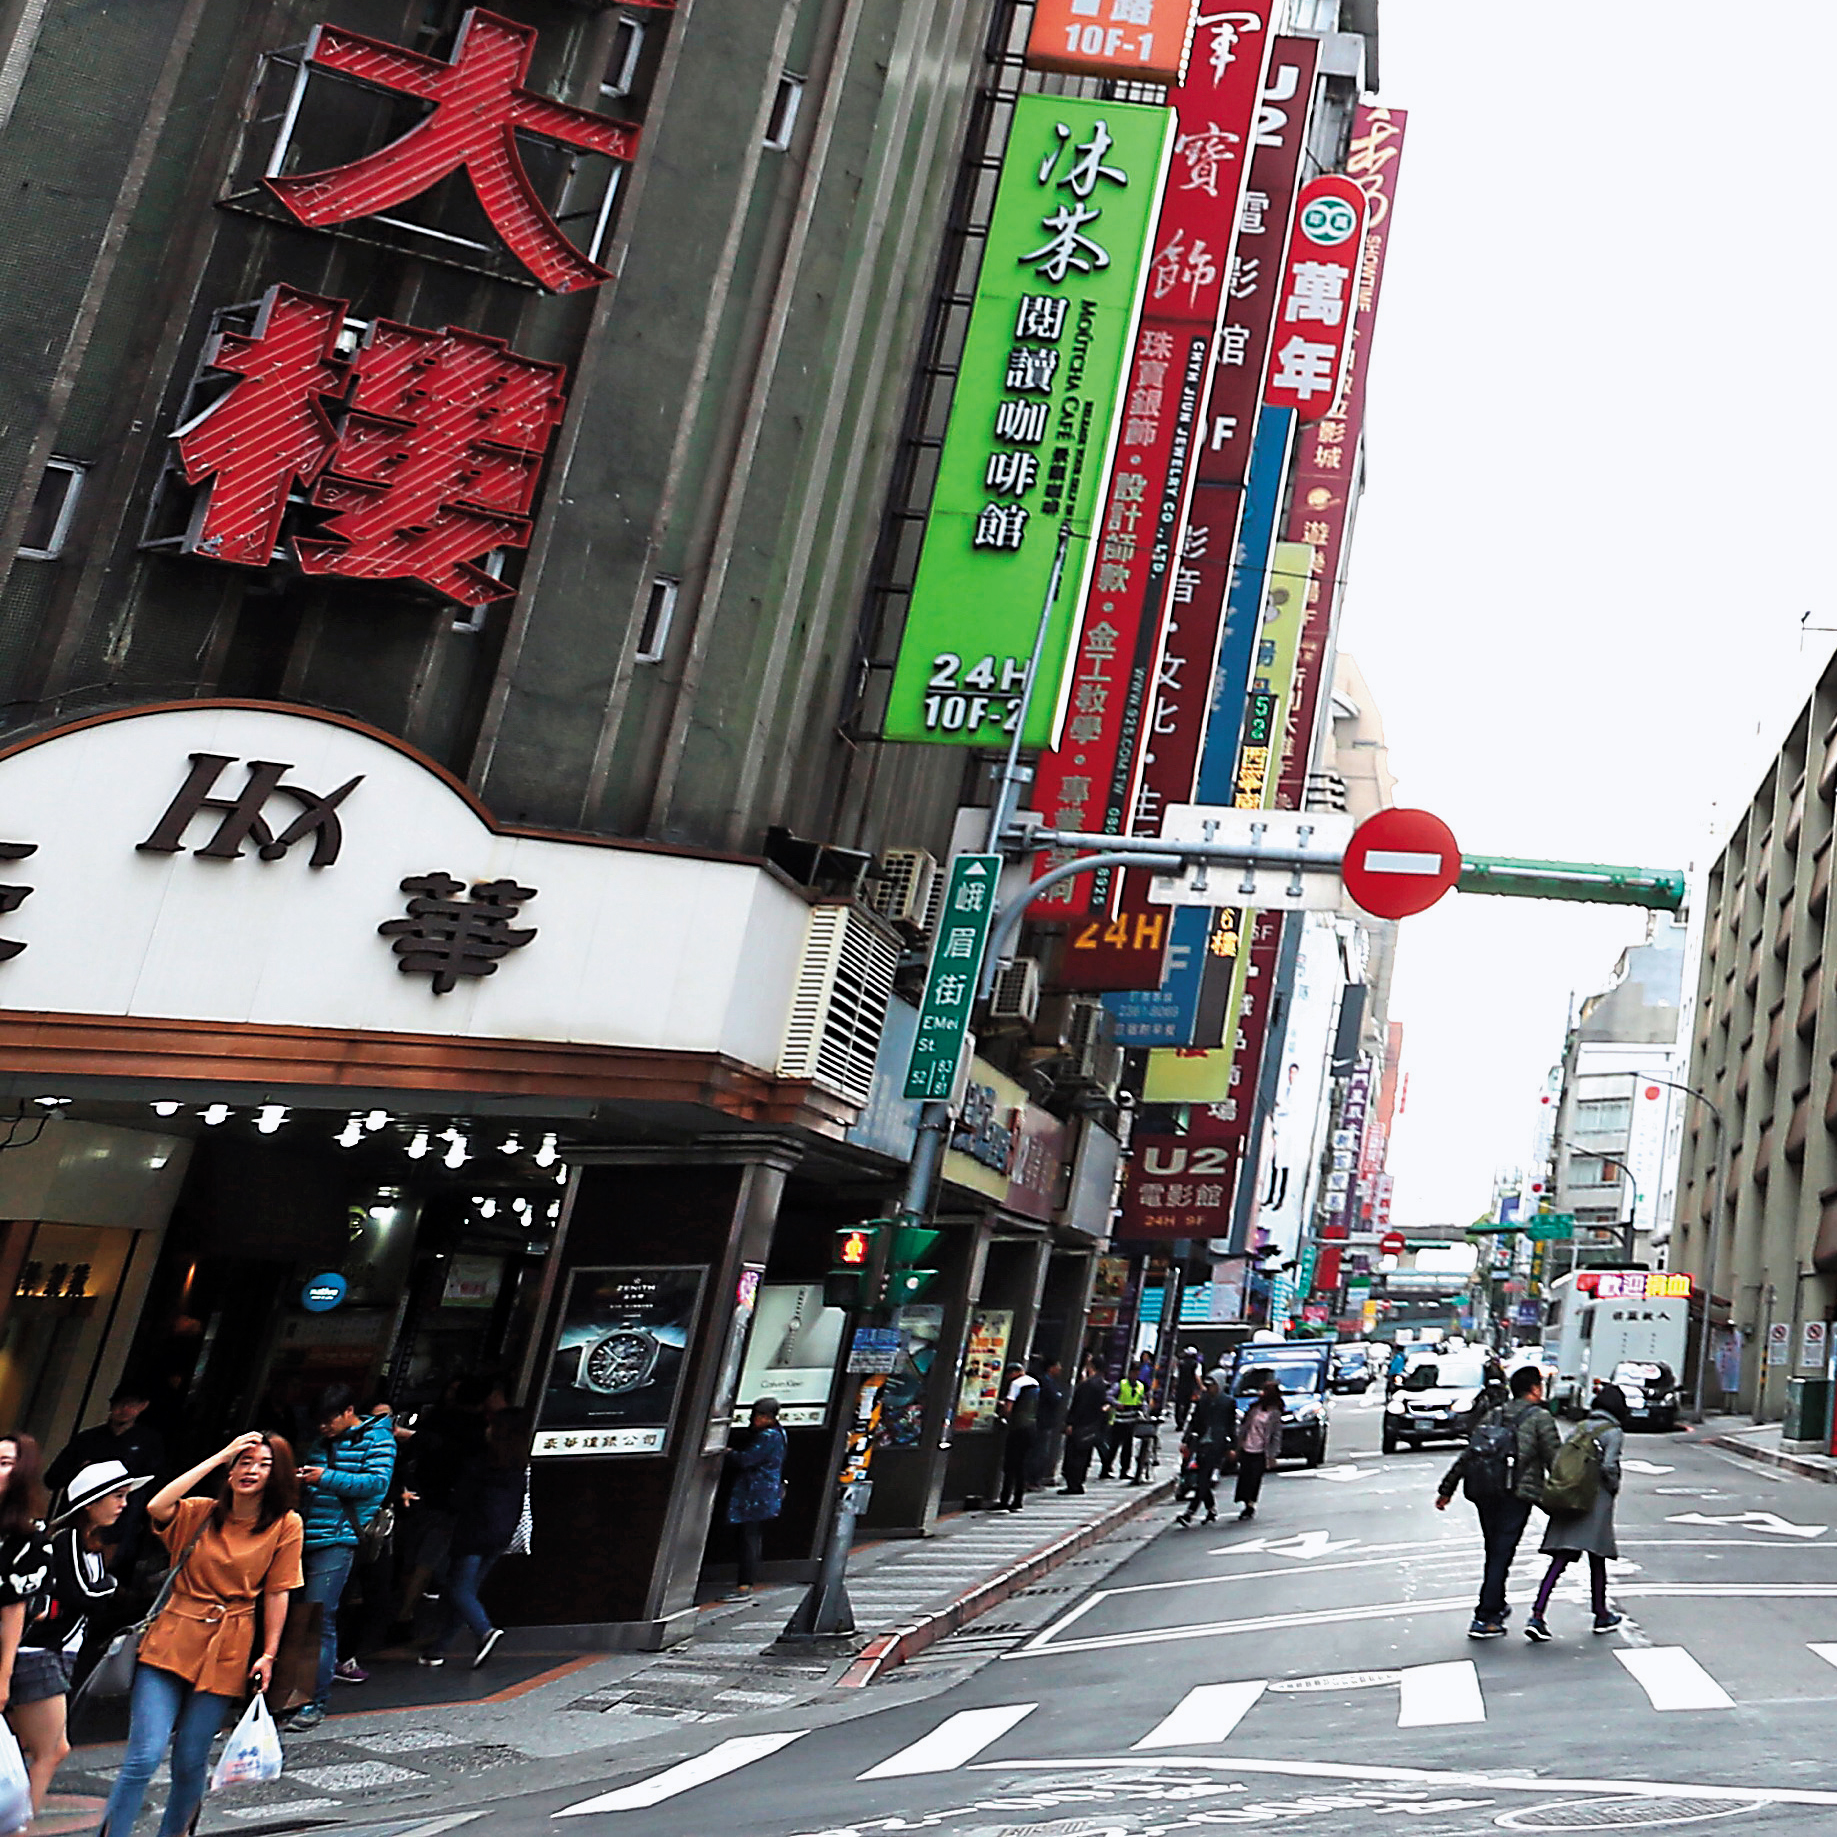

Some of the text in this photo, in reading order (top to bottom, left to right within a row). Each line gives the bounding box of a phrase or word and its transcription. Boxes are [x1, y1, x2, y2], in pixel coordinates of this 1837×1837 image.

[1065, 23, 1155, 63] 10F-1
[1273, 262, 1349, 400] 萬年
[1185, 341, 1206, 382] CHYN
[973, 293, 1071, 551] 閱讀咖啡館
[1179, 386, 1197, 423] JIUN
[1166, 426, 1189, 497] JEWELRY
[928, 653, 1030, 691] 24H
[924, 694, 1024, 733] 10F-2
[934, 881, 987, 1005] 峨眉街
[922, 1015, 959, 1031] EMei
[1144, 1147, 1229, 1175] U2
[1139, 1184, 1223, 1208] 電影館
[1144, 1215, 1176, 1226] 24H
[616, 1284, 657, 1292] ZENITH
